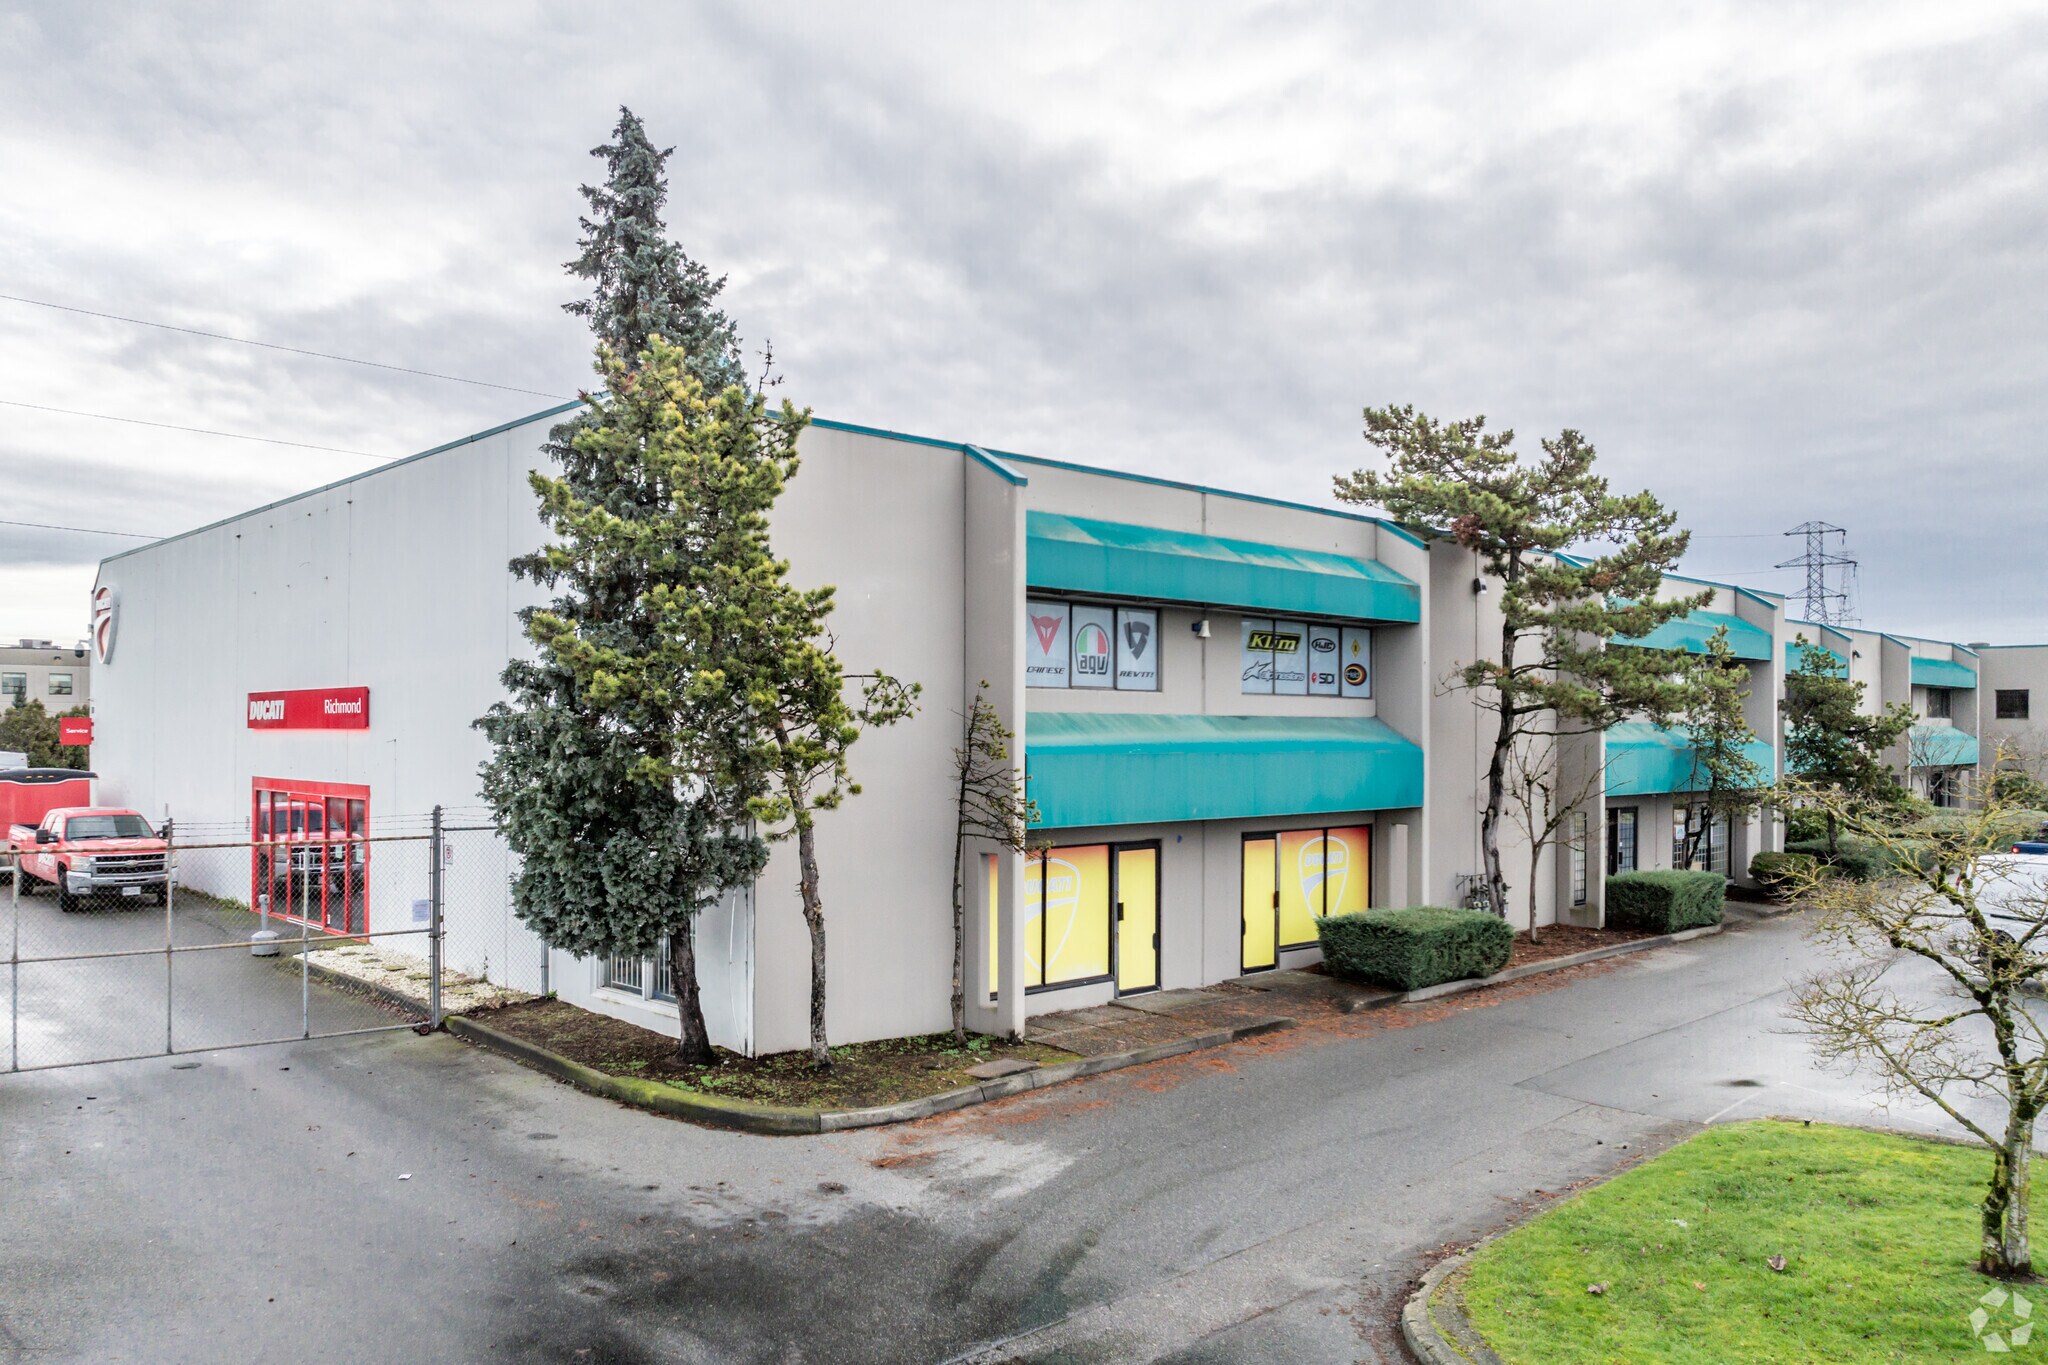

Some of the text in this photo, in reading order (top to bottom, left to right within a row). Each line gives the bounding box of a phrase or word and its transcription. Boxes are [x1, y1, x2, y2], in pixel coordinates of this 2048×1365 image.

[1080, 655, 1105, 674] agv
[1261, 669, 1304, 682] alpnestars
[249, 697, 361, 720] DUCATI Richmond
[1025, 876, 1072, 894] UATI
